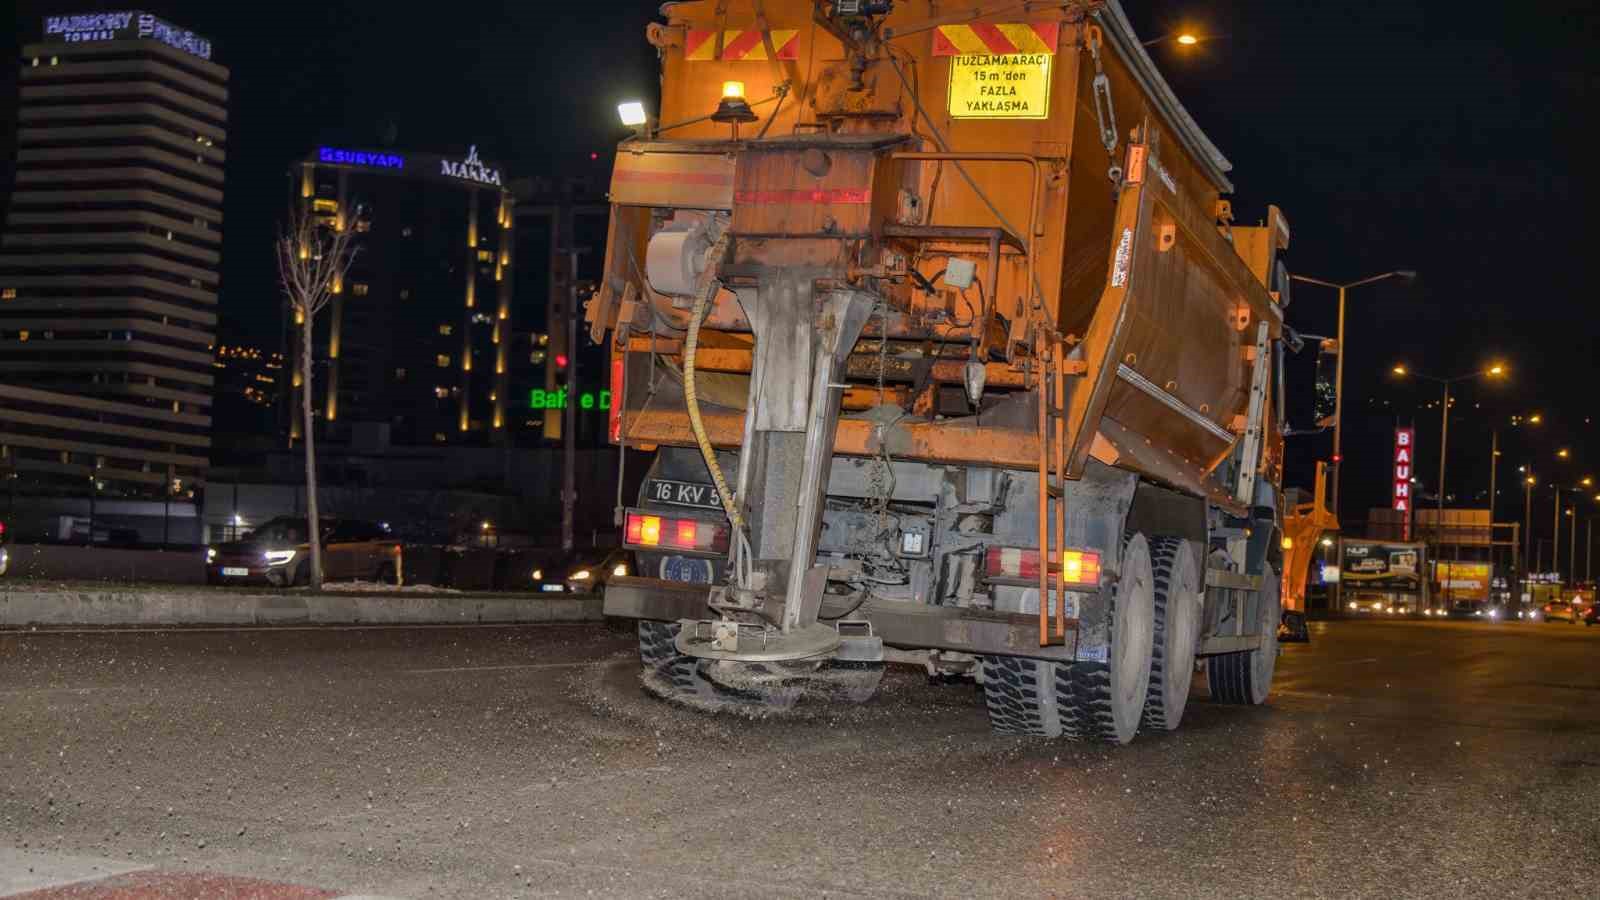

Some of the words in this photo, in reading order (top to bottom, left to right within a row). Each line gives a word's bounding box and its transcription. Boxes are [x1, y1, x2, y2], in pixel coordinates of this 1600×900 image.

[64, 30, 114, 41] TOWERS
[956, 55, 1008, 66] TUZLAMA
[1012, 55, 1047, 65] ARACI
[974, 71, 986, 81] 15
[989, 73, 999, 81] m
[980, 86, 1017, 96] FAZLA
[966, 101, 1029, 112] YAKLAŞMA
[530, 388, 594, 409] Bahe
[656, 482, 672, 500] 16
[677, 485, 704, 503] KV
